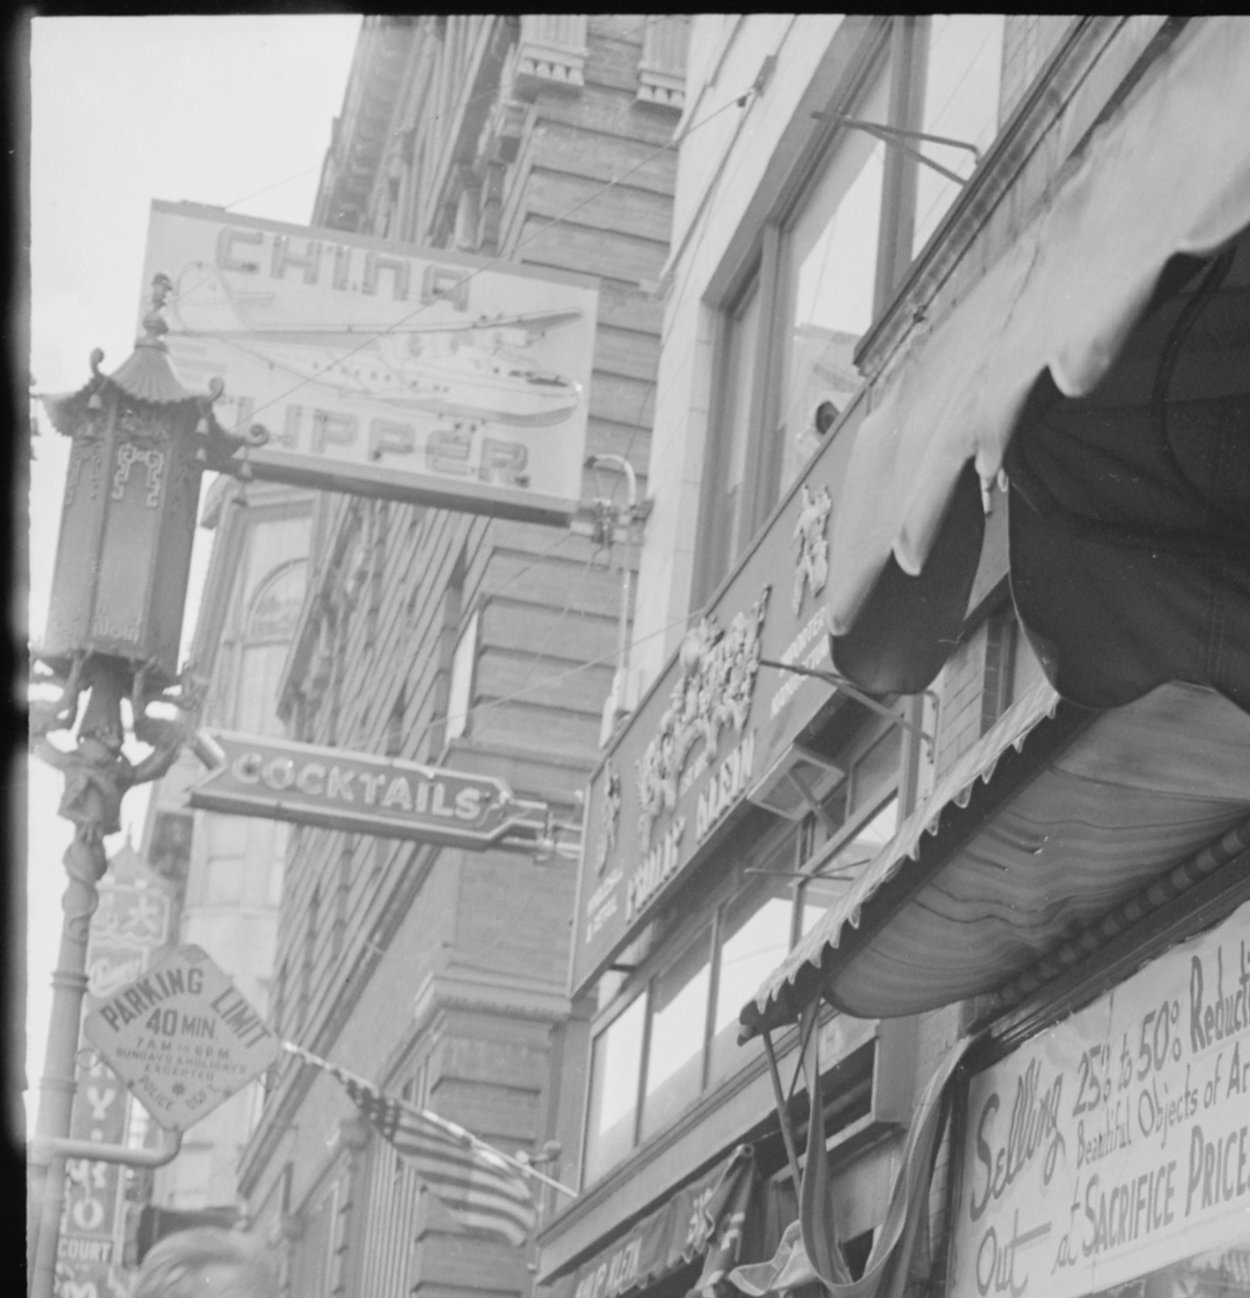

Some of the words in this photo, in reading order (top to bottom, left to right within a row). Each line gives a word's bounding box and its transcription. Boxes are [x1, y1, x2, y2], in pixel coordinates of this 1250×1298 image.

[215, 226, 471, 312] CHINA
[214, 394, 531, 489] LIPPER
[231, 750, 482, 820] COCKTAILS
[99, 967, 204, 1033] PARKING
[210, 984, 271, 1049] LIMIT
[145, 1007, 178, 1037] 40
[116, 1047, 172, 1065] SUNDAYS
[185, 1058, 246, 1074] HOLIDAYS
[138, 1075, 173, 1110] POLICE
[144, 1063, 215, 1081] EXCEPTED
[968, 1056, 1066, 1222] Selling
[1118, 1033, 1132, 1091] to
[1137, 1000, 1181, 1081] 50%
[1076, 1095, 1132, 1170] Beautiful
[1138, 1063, 1198, 1150] Objects
[1204, 1053, 1223, 1109] of
[58, 1240, 112, 1262] COURT
[975, 1208, 1052, 1298] Out
[1051, 1178, 1080, 1275] at
[1081, 1160, 1177, 1257] SACRIFICE
